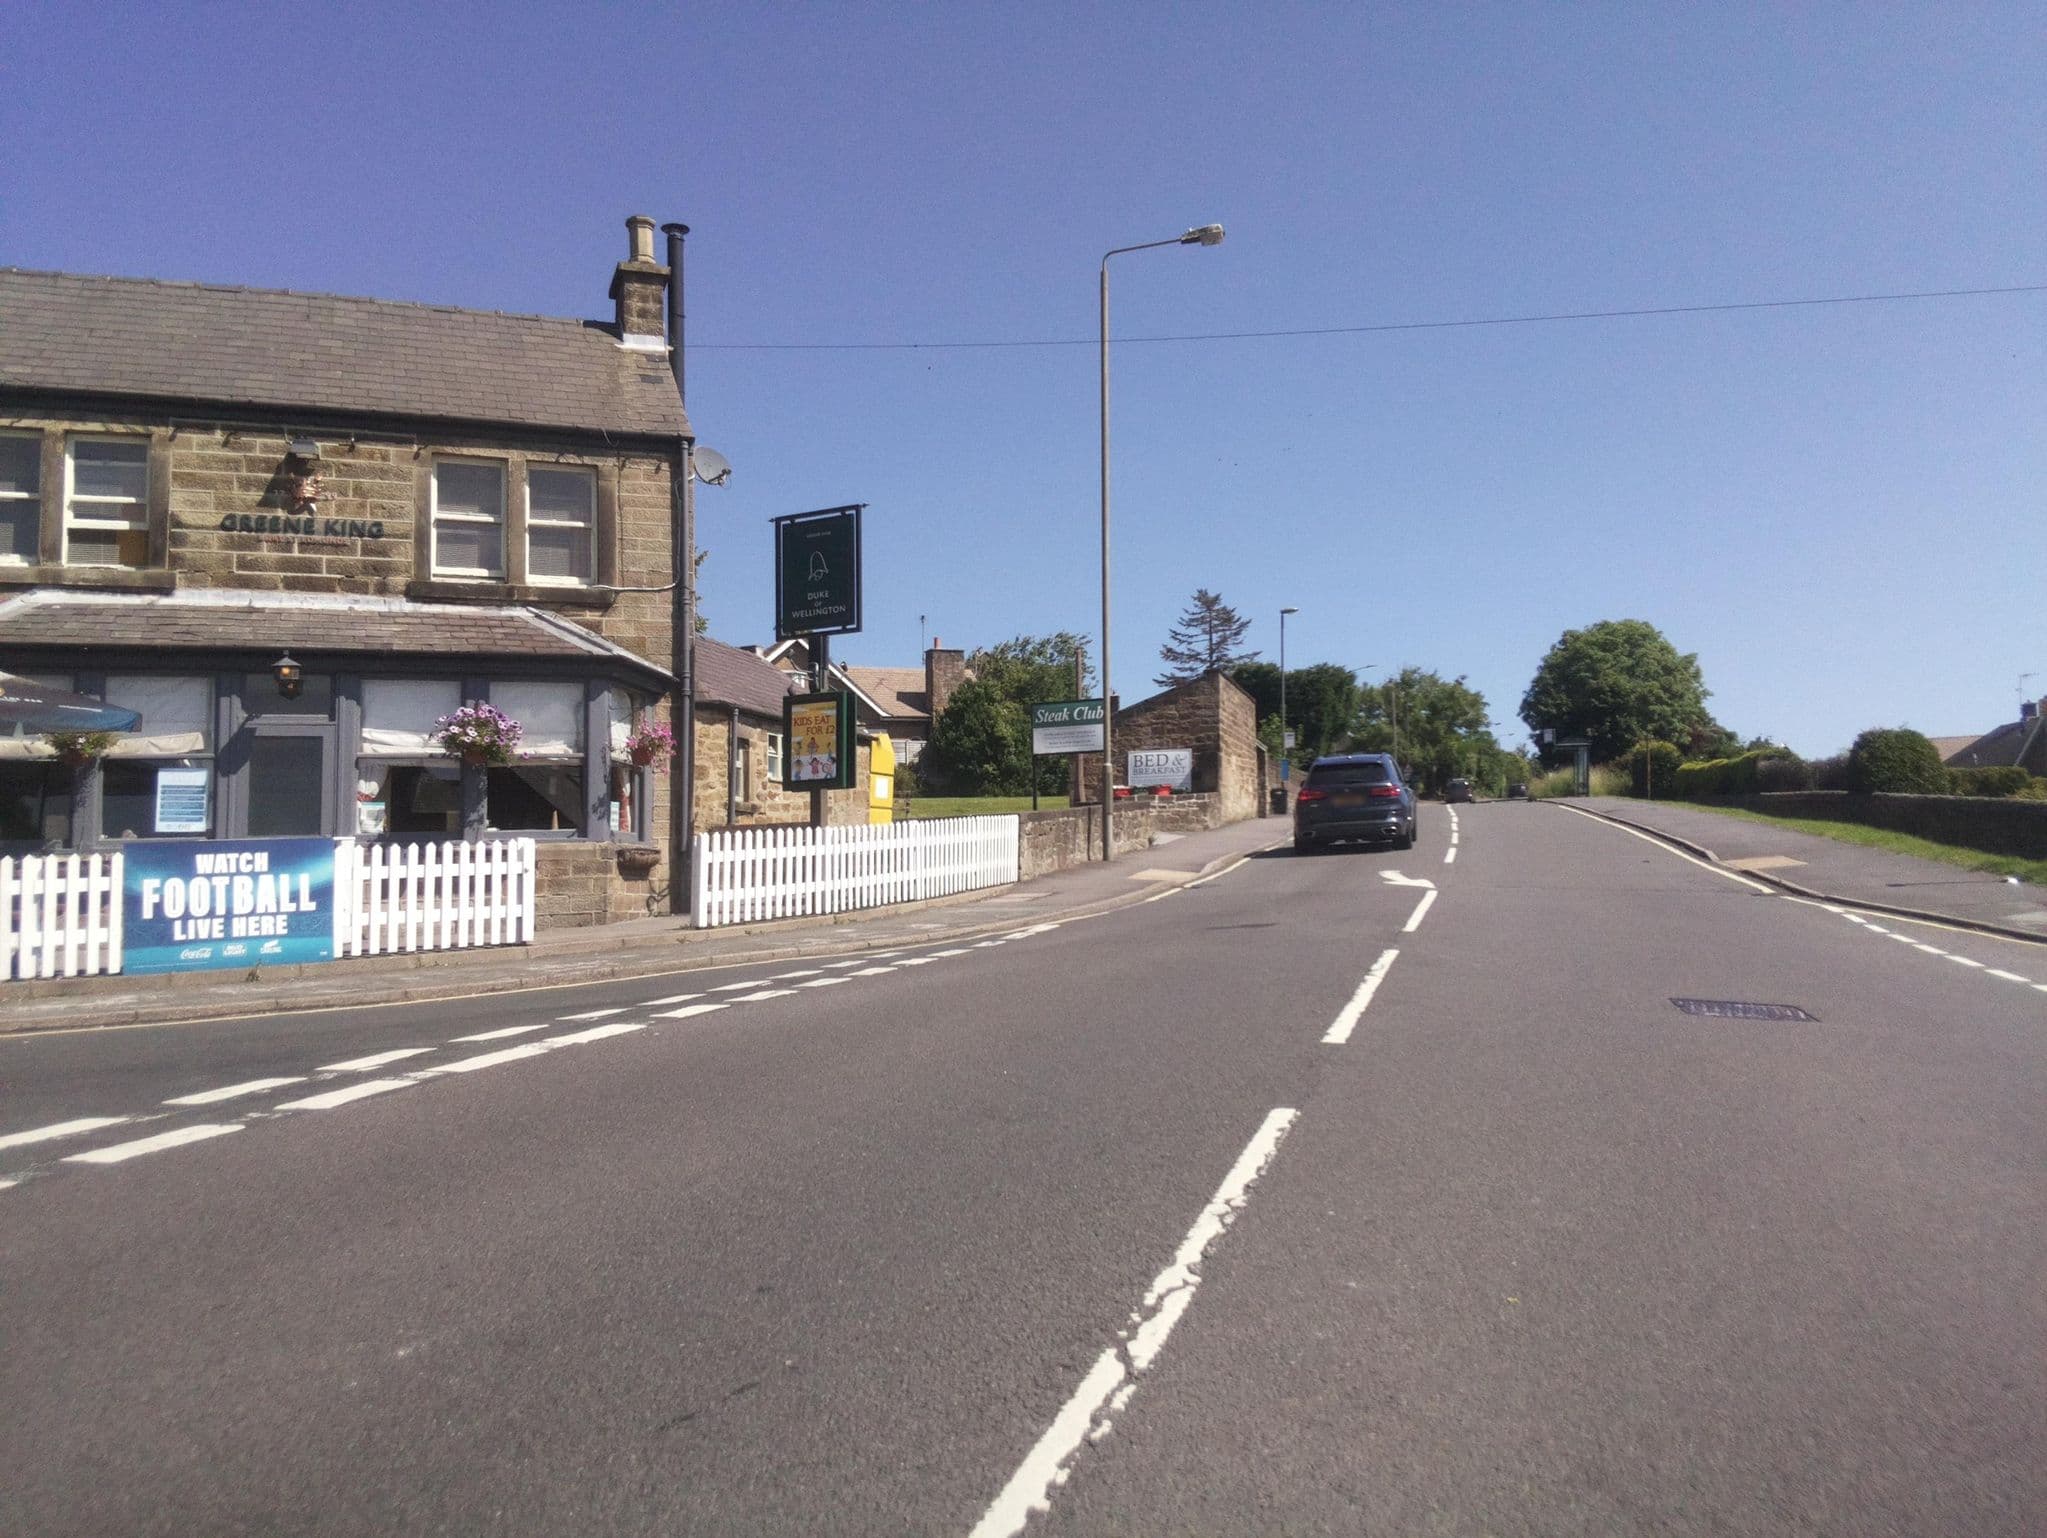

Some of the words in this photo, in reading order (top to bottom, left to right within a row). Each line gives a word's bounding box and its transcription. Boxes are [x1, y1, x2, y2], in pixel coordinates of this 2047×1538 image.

[220, 513, 315, 535] GREENE
[324, 519, 384, 538] KING
[807, 590, 830, 600] DUKE
[792, 605, 847, 618] WELLINGTON
[1035, 707, 1070, 723] Steak
[1073, 705, 1104, 721] Club
[793, 716, 813, 727] KIDS
[814, 715, 831, 725] EAT
[806, 726, 823, 735] FOR
[1134, 754, 1169, 767] BED
[1132, 766, 1185, 776] BREAKFAST
[195, 851, 269, 874] WATCH
[142, 873, 317, 920] FOOTBALL
[173, 918, 225, 941] LIVE
[232, 914, 288, 938] HERE
